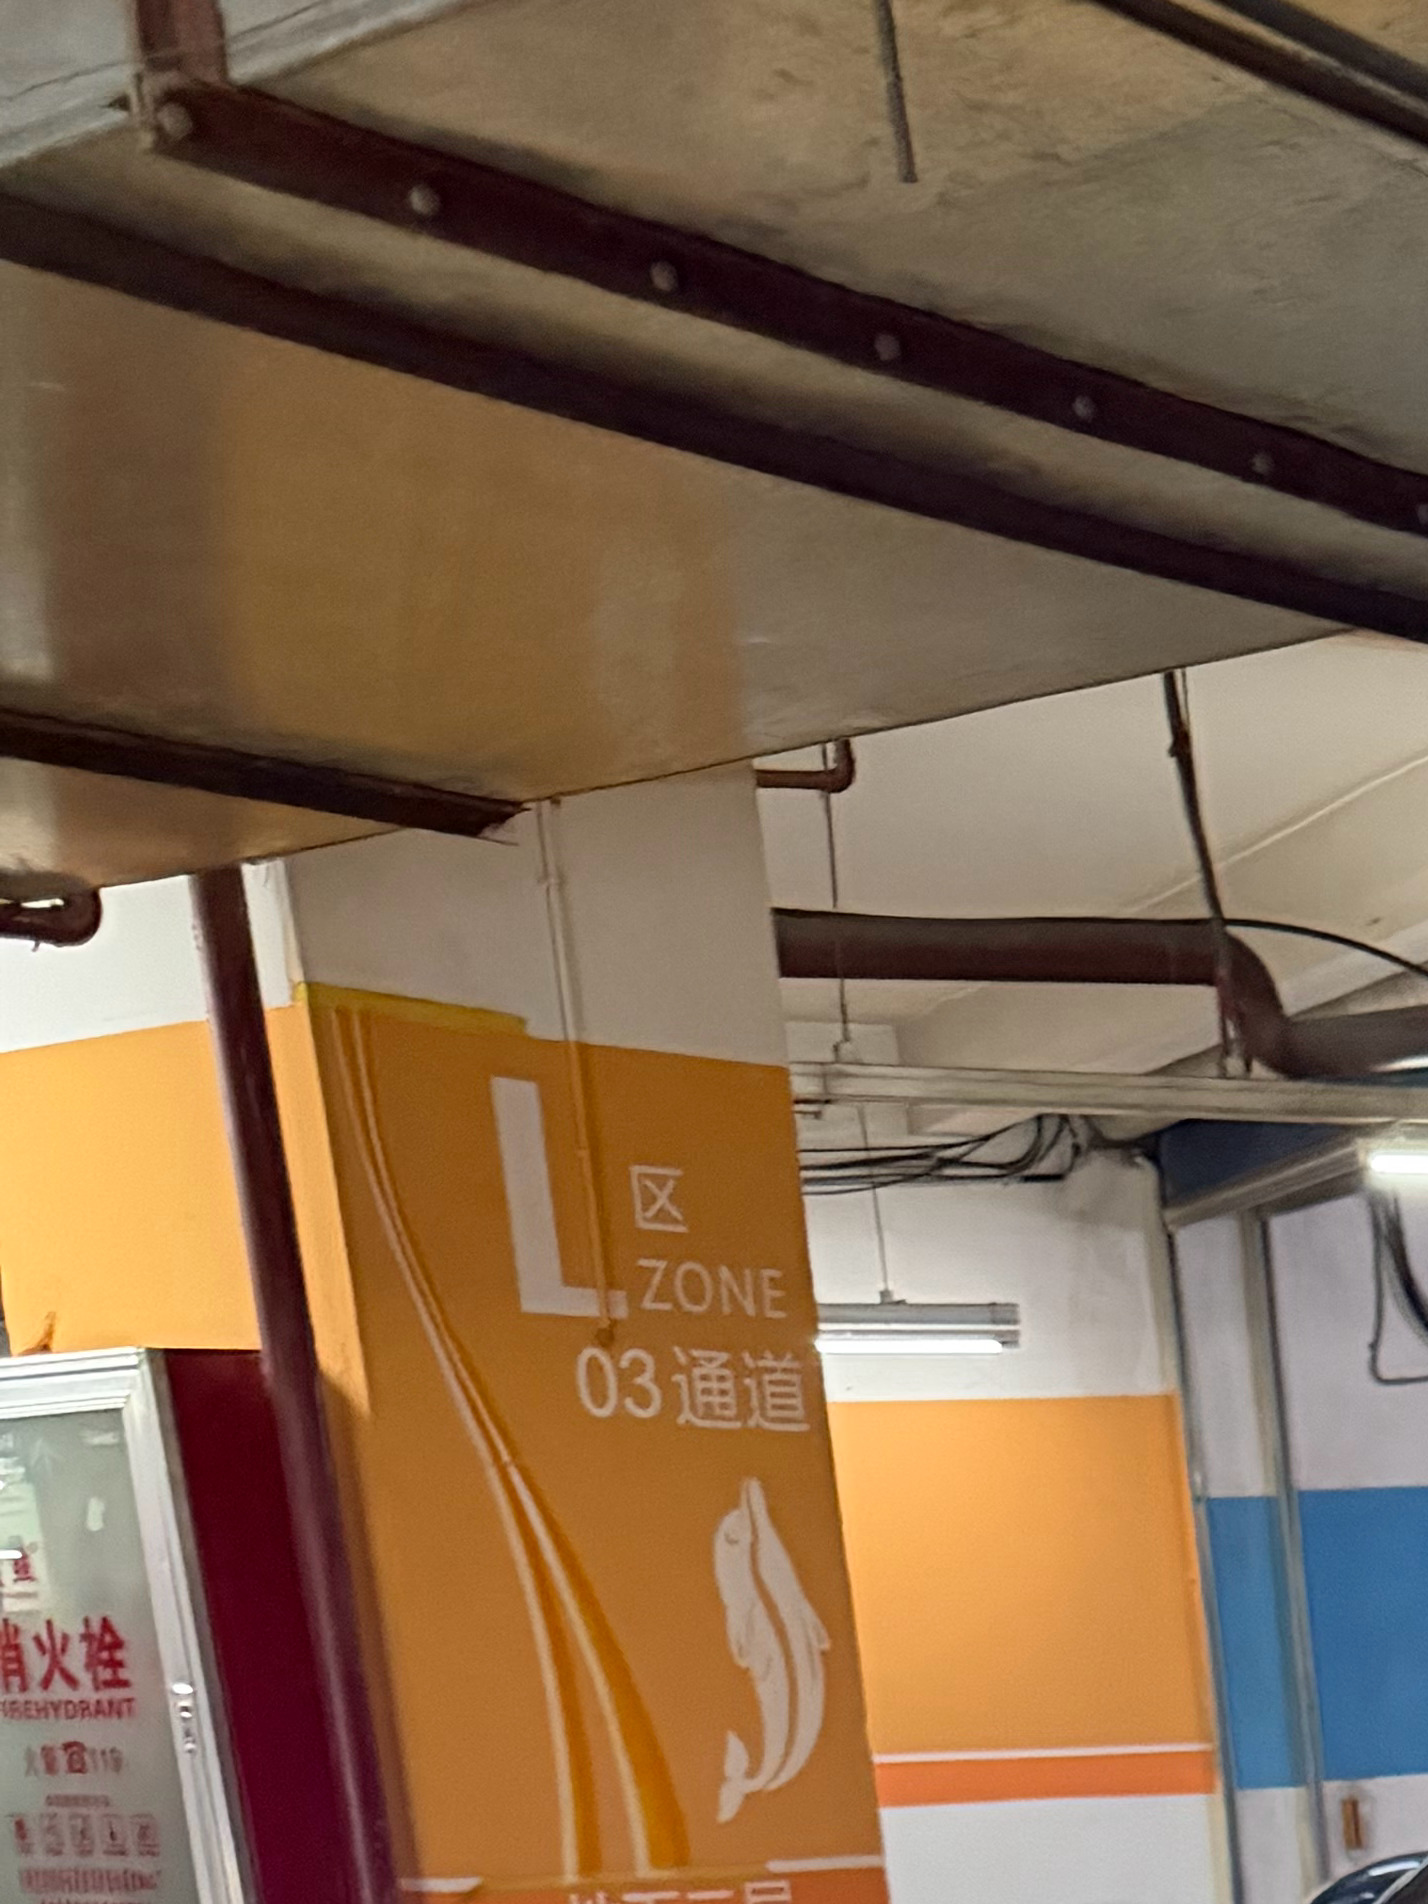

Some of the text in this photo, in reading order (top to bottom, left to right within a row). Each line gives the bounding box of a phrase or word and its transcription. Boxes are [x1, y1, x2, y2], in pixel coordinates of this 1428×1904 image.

[491, 1076, 629, 1319] L
[629, 1165, 689, 1233] 区
[636, 1258, 787, 1319] ZONE
[0, 1697, 136, 1720] IREHYDRANT
